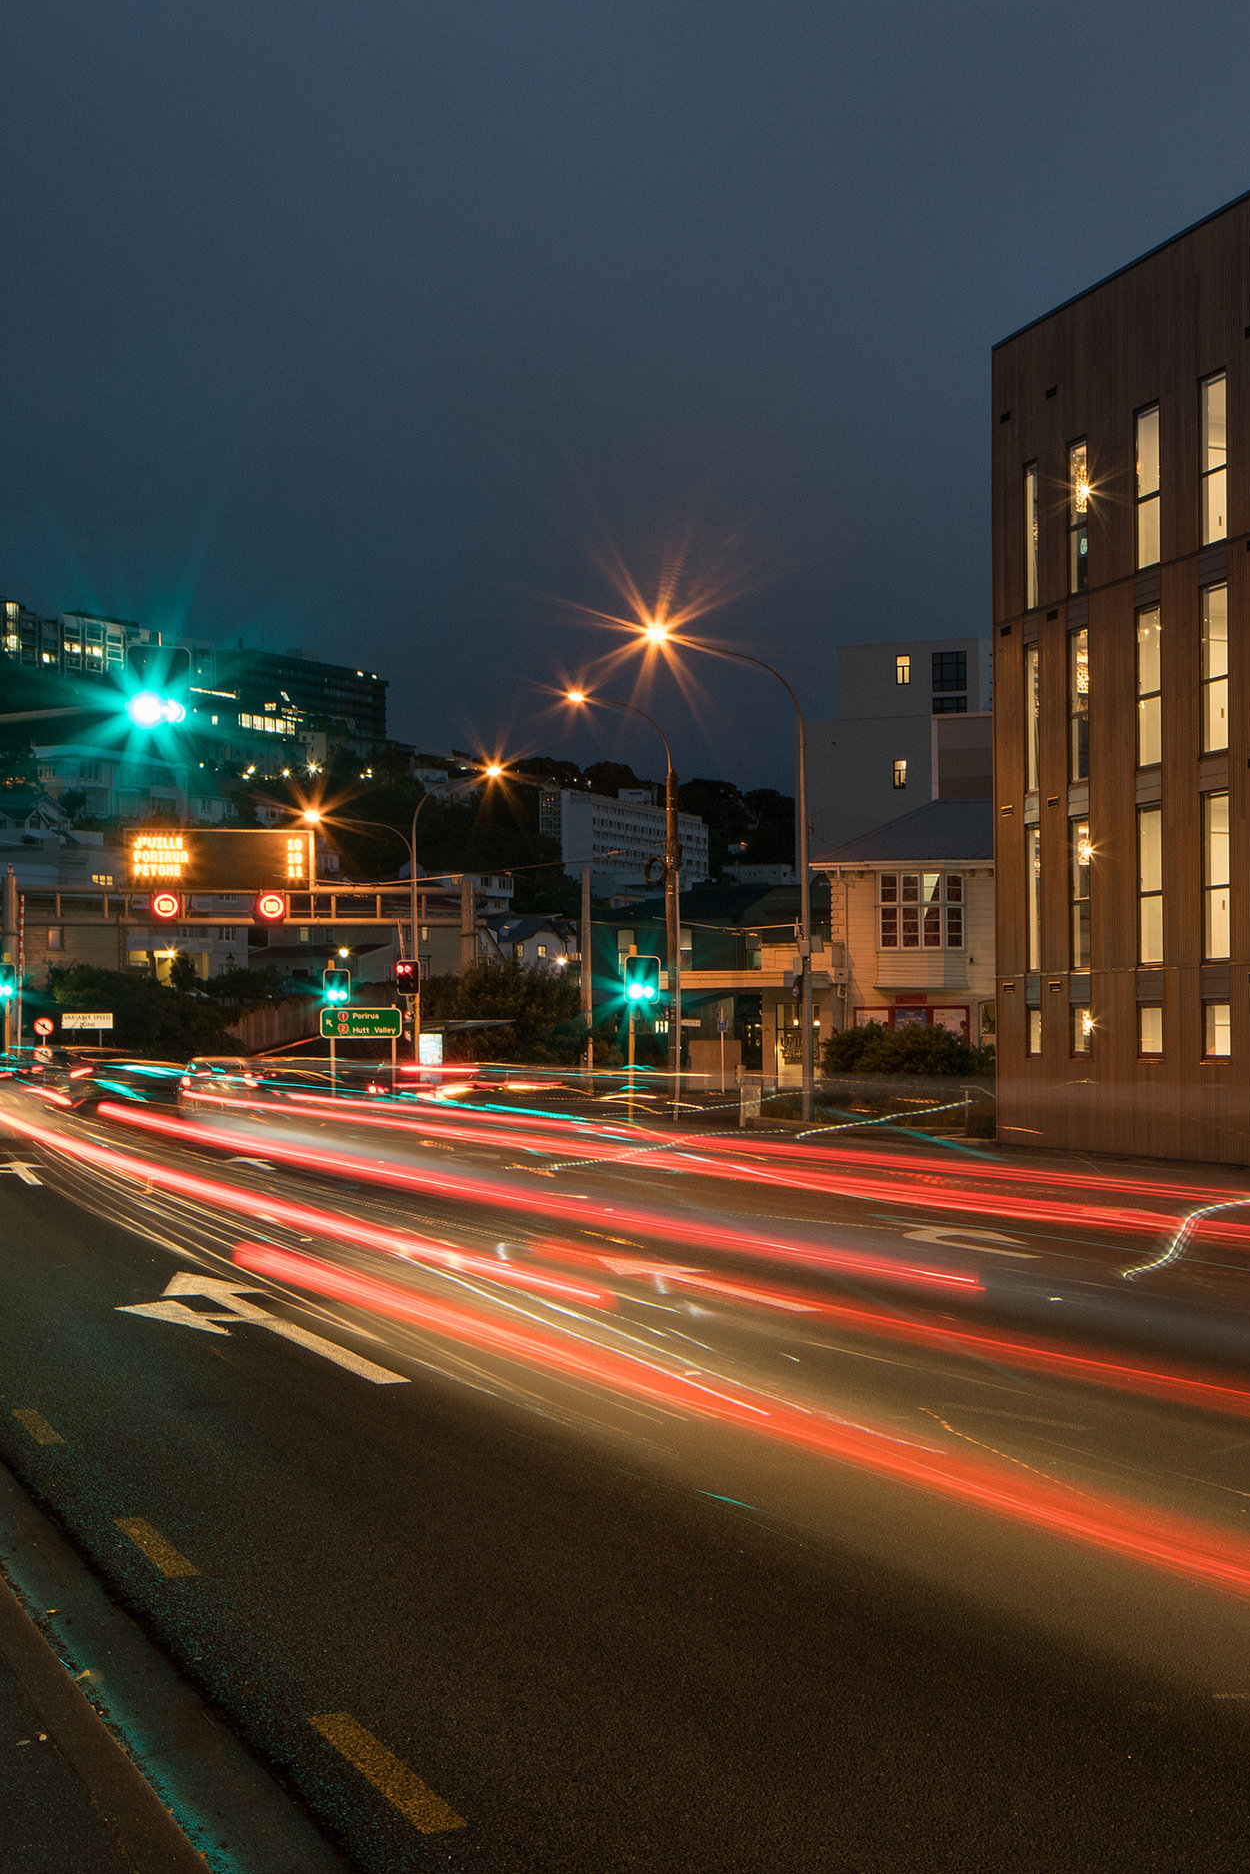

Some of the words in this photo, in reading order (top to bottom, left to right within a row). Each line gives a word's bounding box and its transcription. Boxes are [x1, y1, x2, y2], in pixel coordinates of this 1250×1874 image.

[133, 837, 183, 849] J'VILLE
[133, 851, 189, 863] PORIRUA
[287, 852, 303, 864] 18
[287, 865, 303, 878] 11
[374, 1026, 396, 1034] Valley
